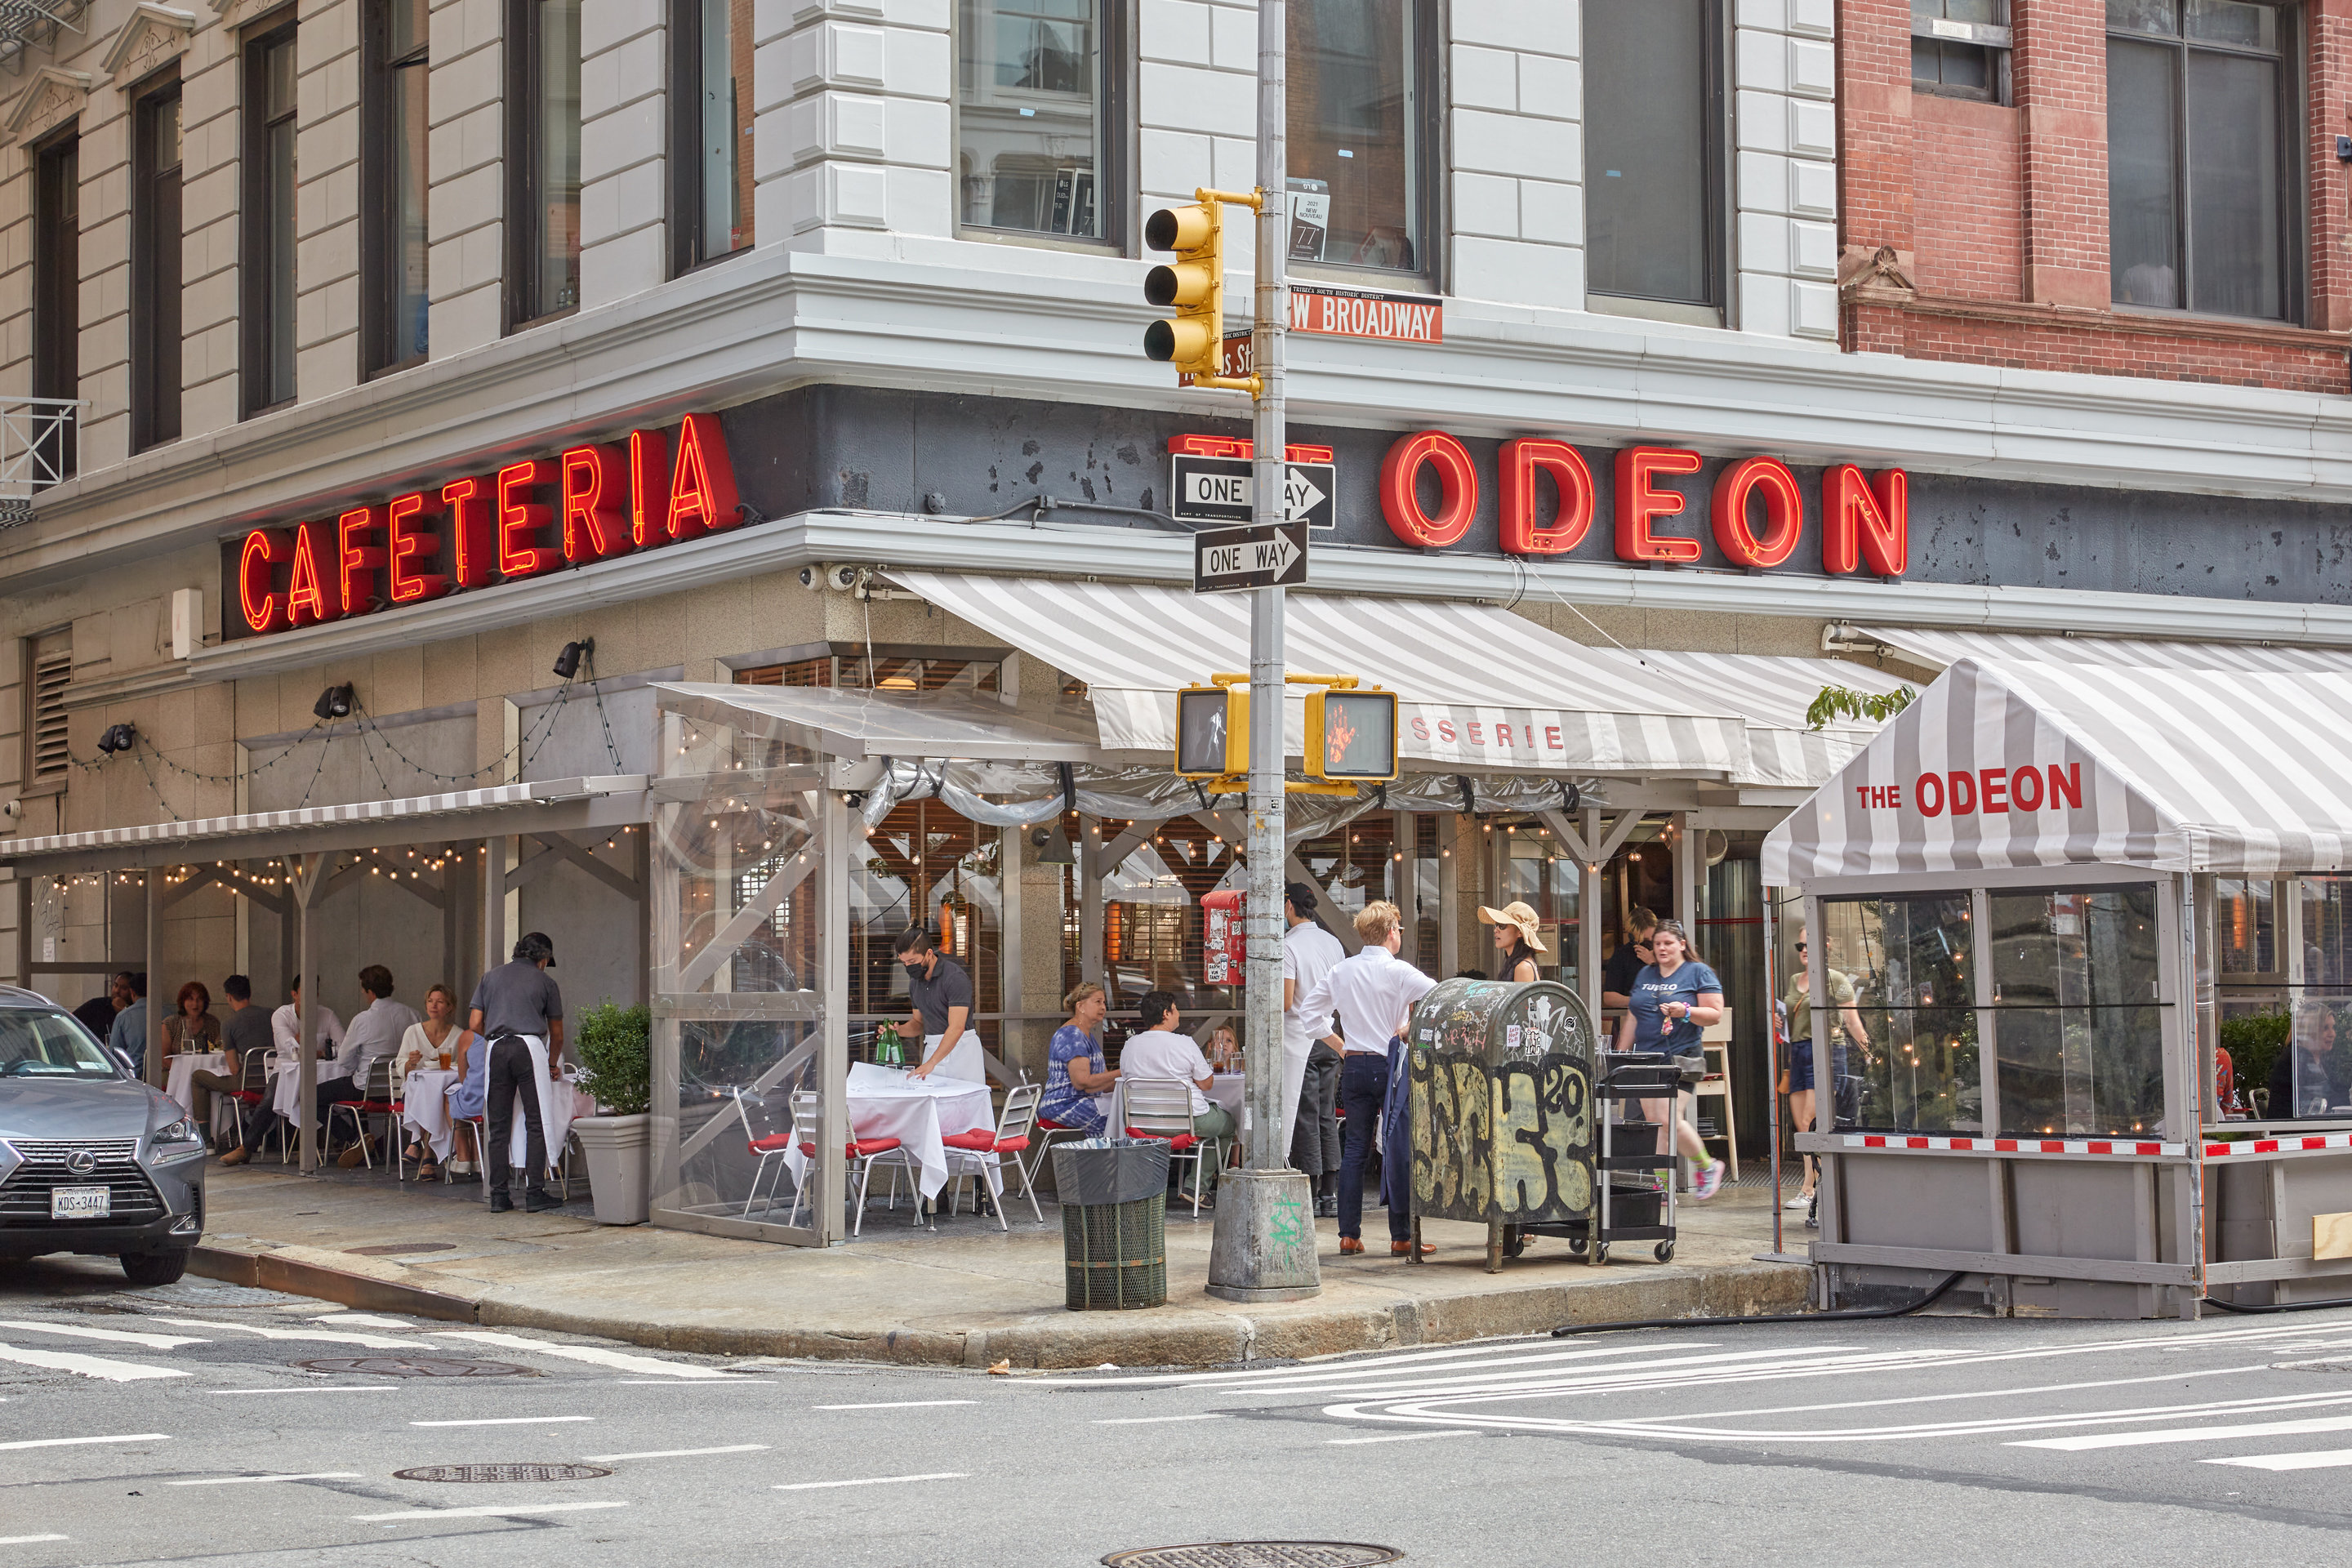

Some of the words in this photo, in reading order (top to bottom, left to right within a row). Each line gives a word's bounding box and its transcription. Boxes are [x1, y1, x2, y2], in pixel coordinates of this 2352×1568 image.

[1293, 286, 1314, 294] TRIBECA
[1335, 290, 1359, 298] HISTORIC
[1361, 292, 1384, 301] DISTRICT
[1293, 293, 1310, 329] W
[1323, 296, 1436, 340] BROADWAY
[1232, 330, 1251, 339] DISTRICT
[1236, 344, 1252, 373] St
[1198, 477, 1243, 503] ONE
[1285, 483, 1310, 507] AY
[1380, 430, 1909, 576] ODEON
[240, 412, 739, 632] CAFETERIA
[1210, 547, 1241, 573] ONE
[1256, 542, 1290, 568] WAY
[1398, 717, 1564, 750] SSERIE
[1856, 785, 1901, 809] THE
[1915, 762, 2082, 817] ODEON
[1544, 1063, 1584, 1119] 20
